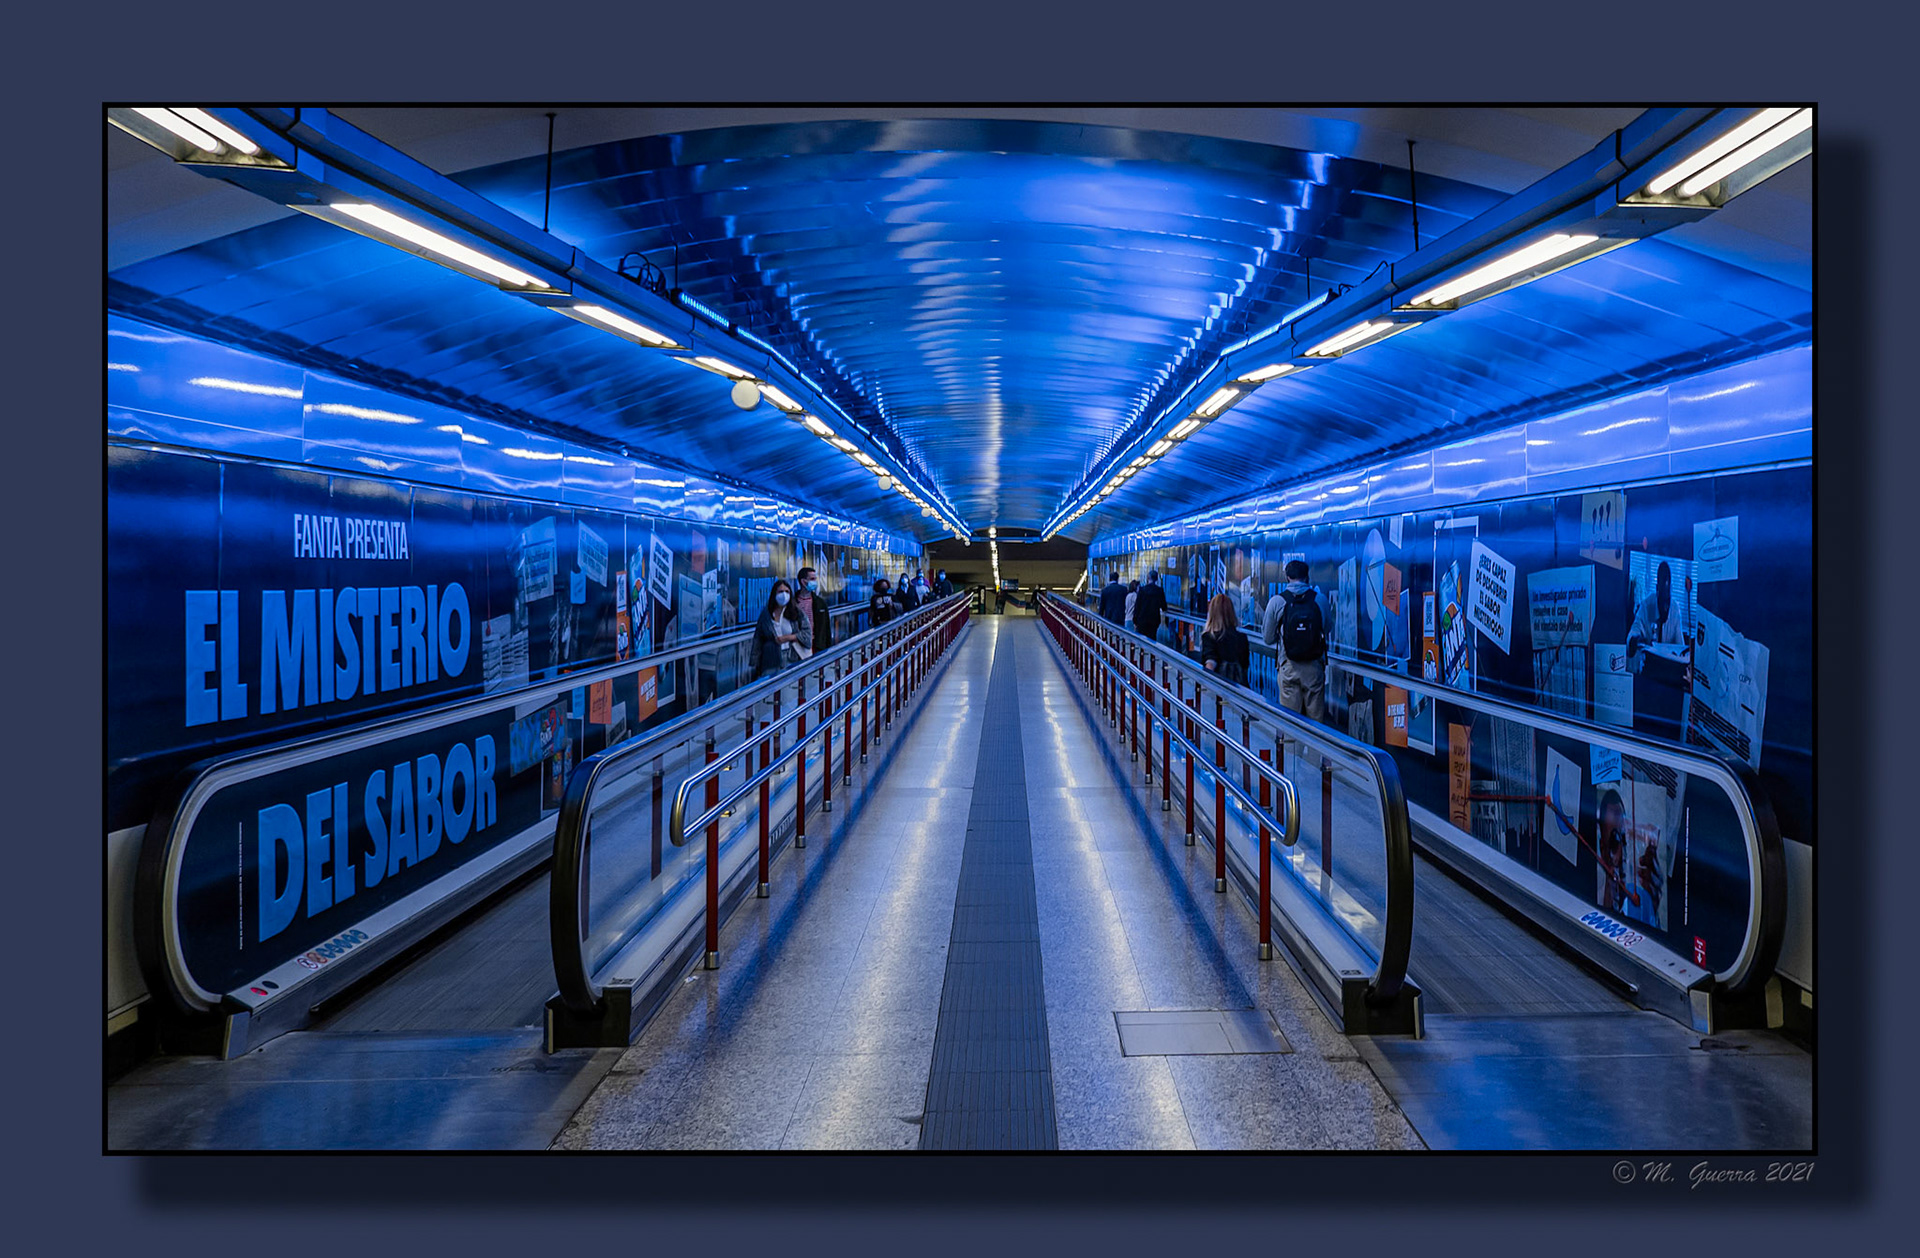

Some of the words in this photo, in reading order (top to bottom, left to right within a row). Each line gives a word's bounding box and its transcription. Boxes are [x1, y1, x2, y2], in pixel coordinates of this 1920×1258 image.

[294, 513, 342, 558] FANTA
[345, 517, 409, 561] PRESENTA
[185, 590, 248, 728] EL
[260, 582, 471, 715] MISTERIO
[258, 782, 355, 942] DEL
[364, 734, 497, 888] SABOR
